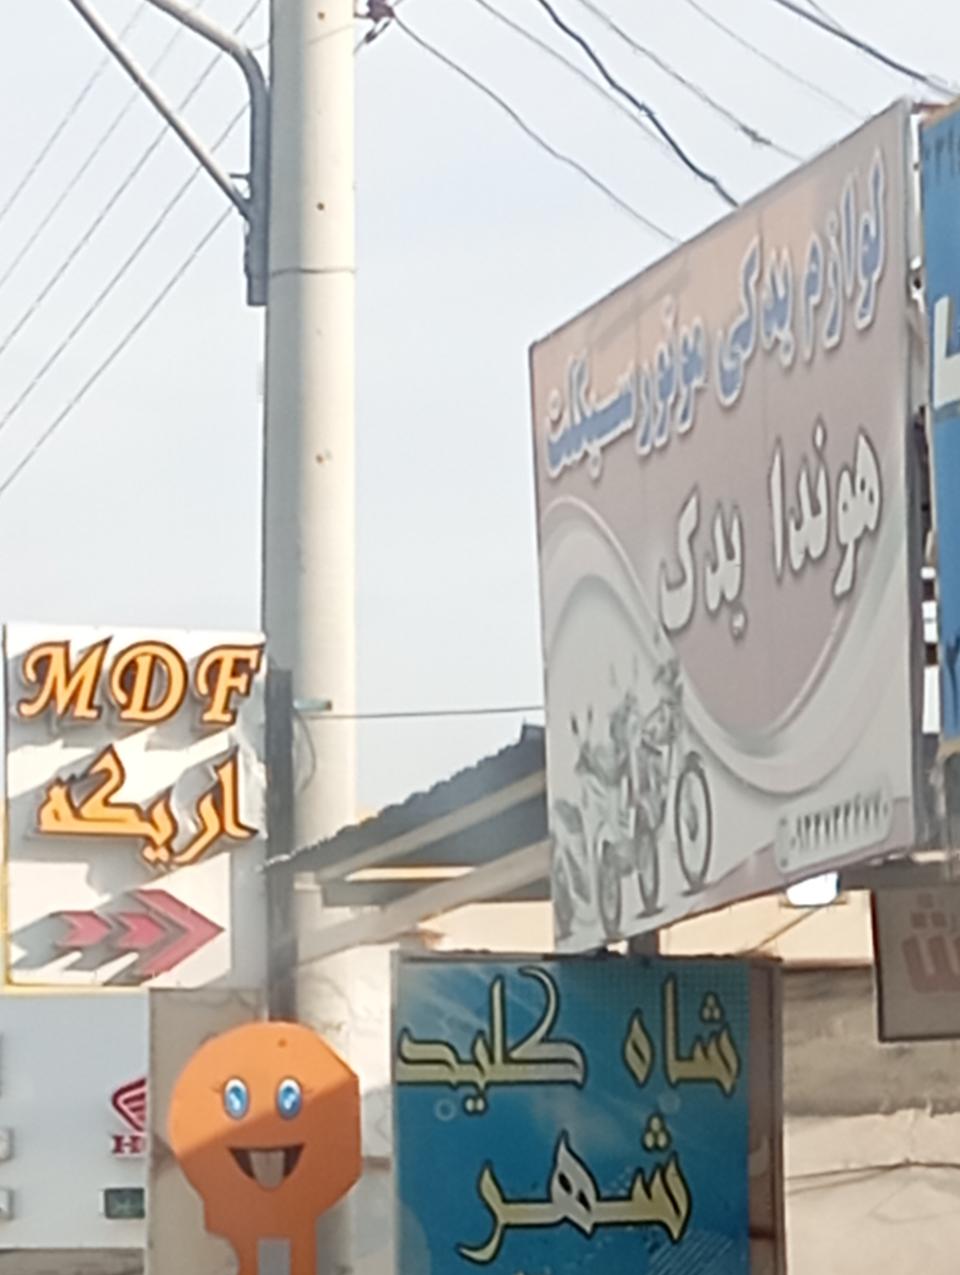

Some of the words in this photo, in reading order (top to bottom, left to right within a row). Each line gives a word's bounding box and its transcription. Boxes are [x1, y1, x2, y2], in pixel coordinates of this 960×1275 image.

[714, 233, 795, 407] یدکی
[803, 147, 887, 361] لوازم
[658, 486, 747, 640] یدک
[769, 422, 882, 597] هوندا
[17, 634, 264, 726] MDF
[37, 743, 258, 867] اریکه
[395, 965, 588, 1116] کلید
[624, 972, 741, 1097] شاه
[456, 1110, 692, 1265] شهر
